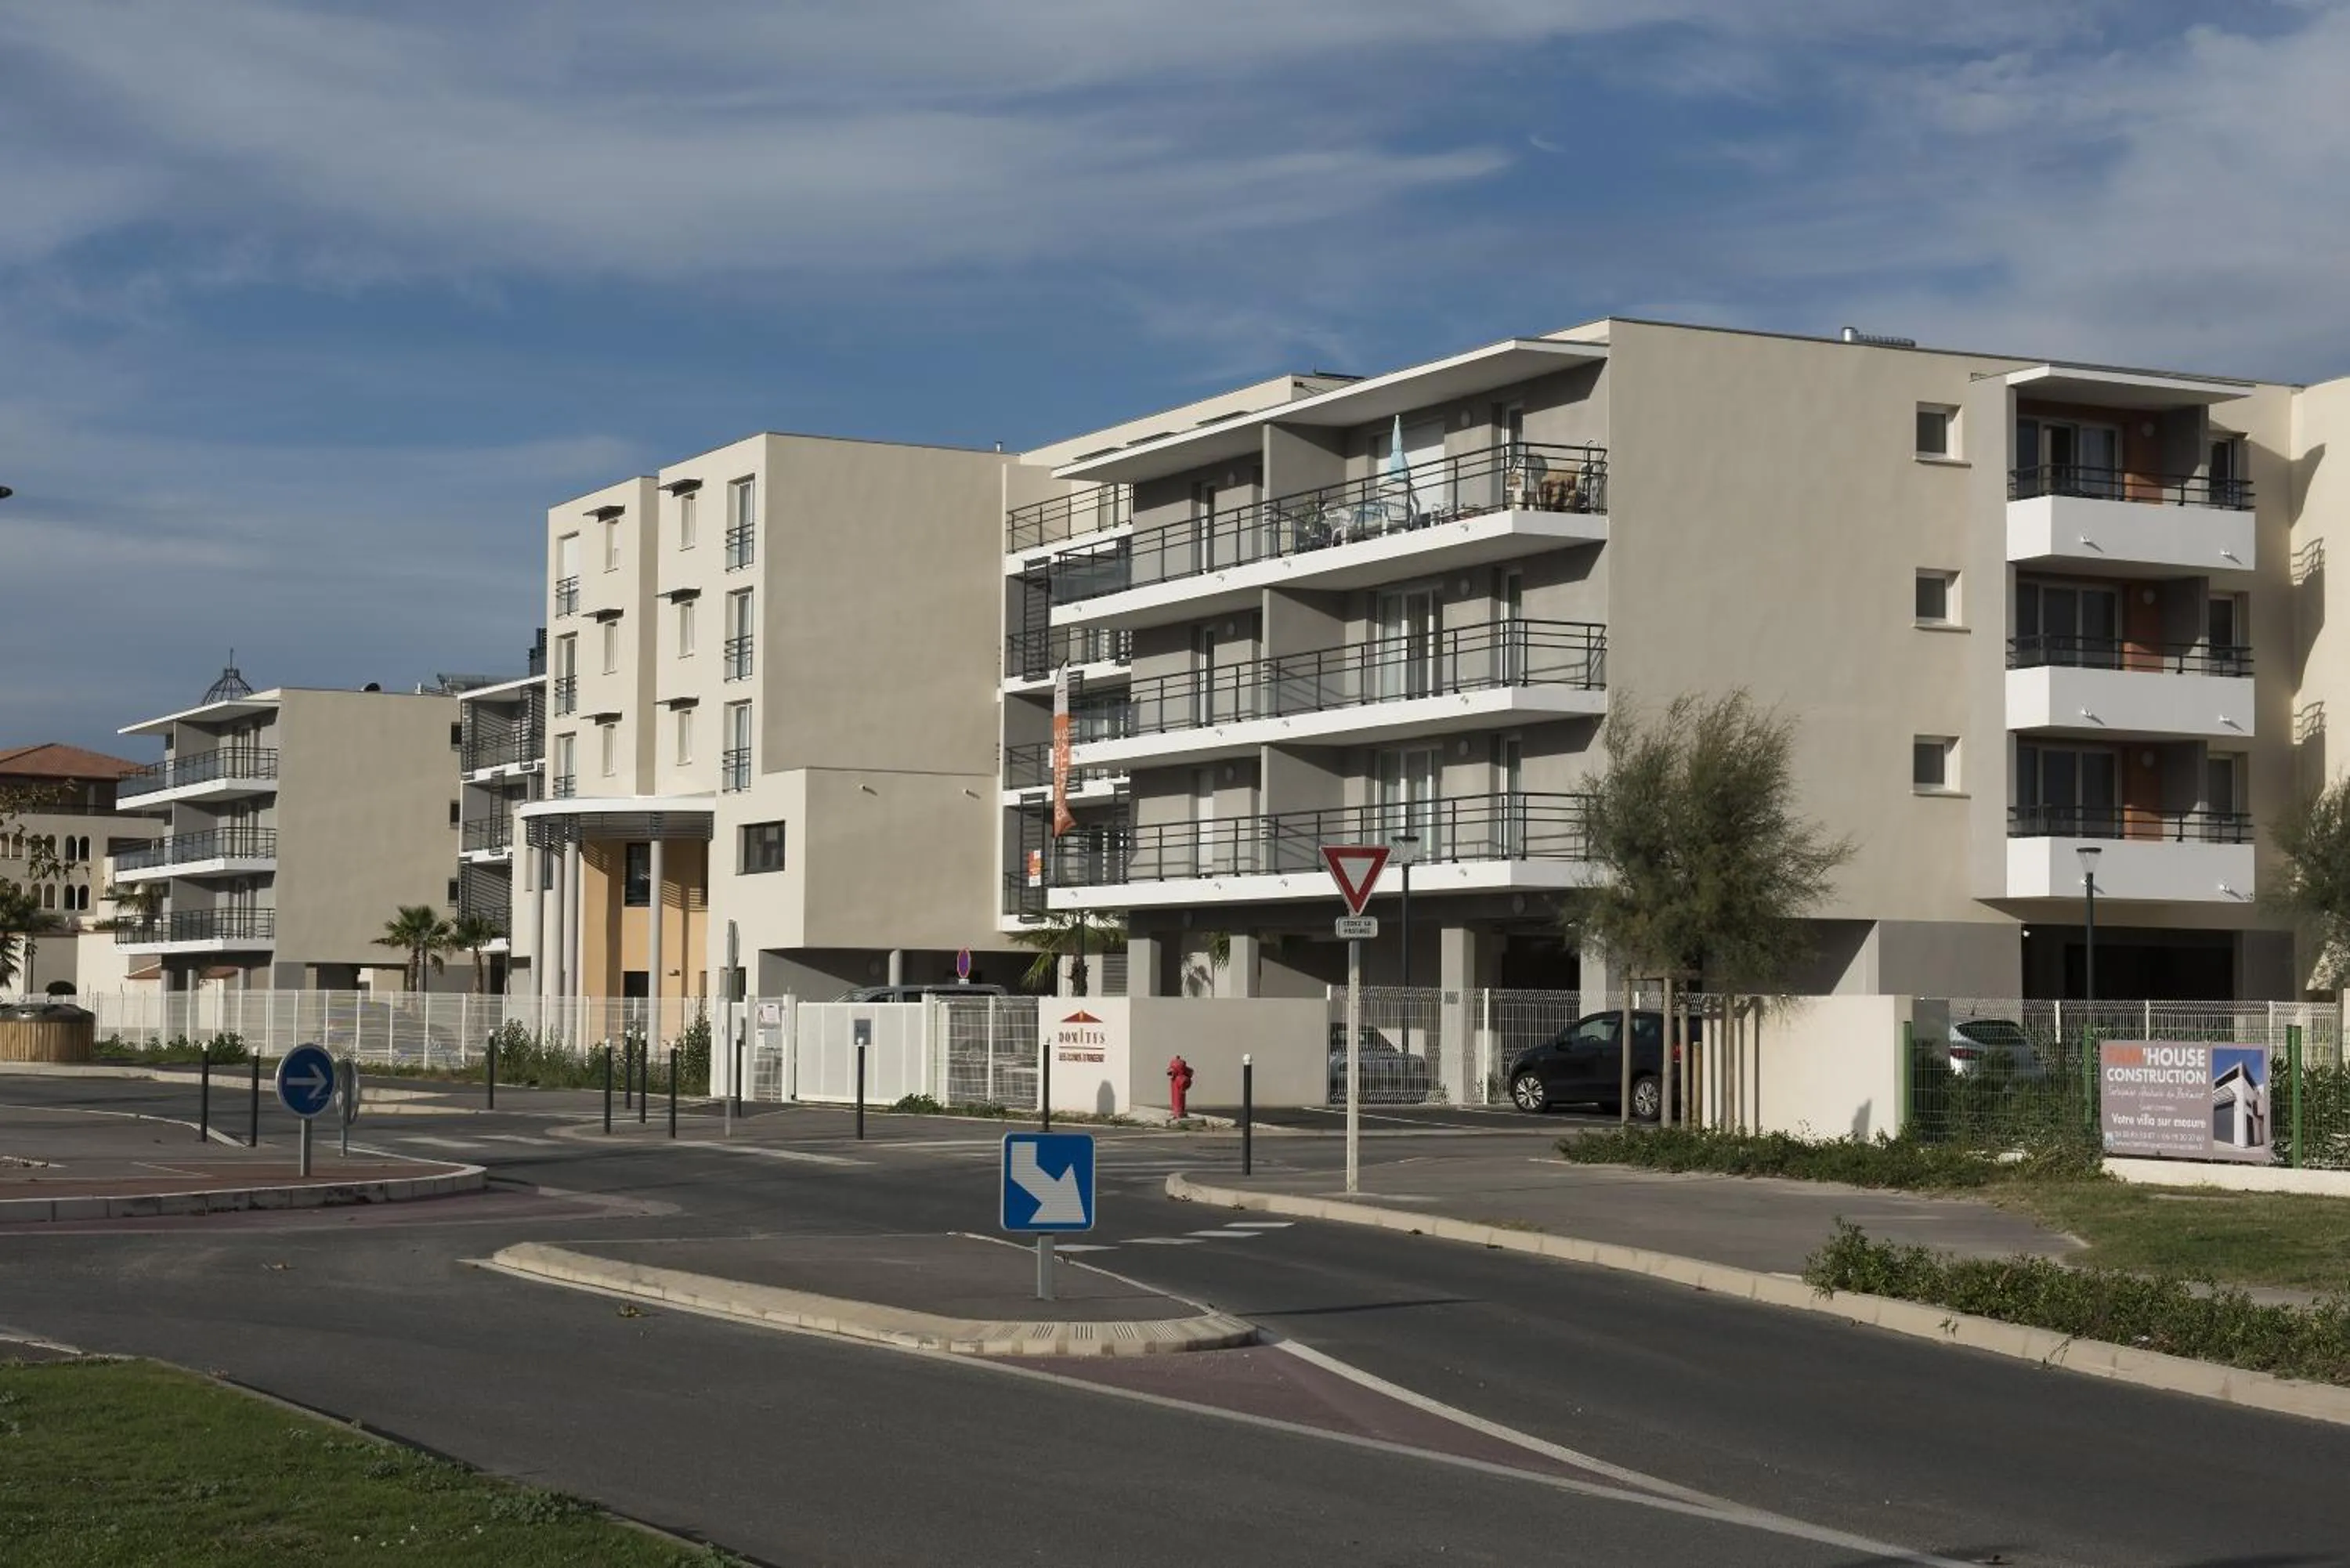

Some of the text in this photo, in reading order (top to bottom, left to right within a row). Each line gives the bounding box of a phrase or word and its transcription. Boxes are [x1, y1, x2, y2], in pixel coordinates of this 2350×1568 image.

[2106, 1068, 2207, 1084] CONSTRUCTION
[2111, 1112, 2207, 1129] Votre villa sur mesure
